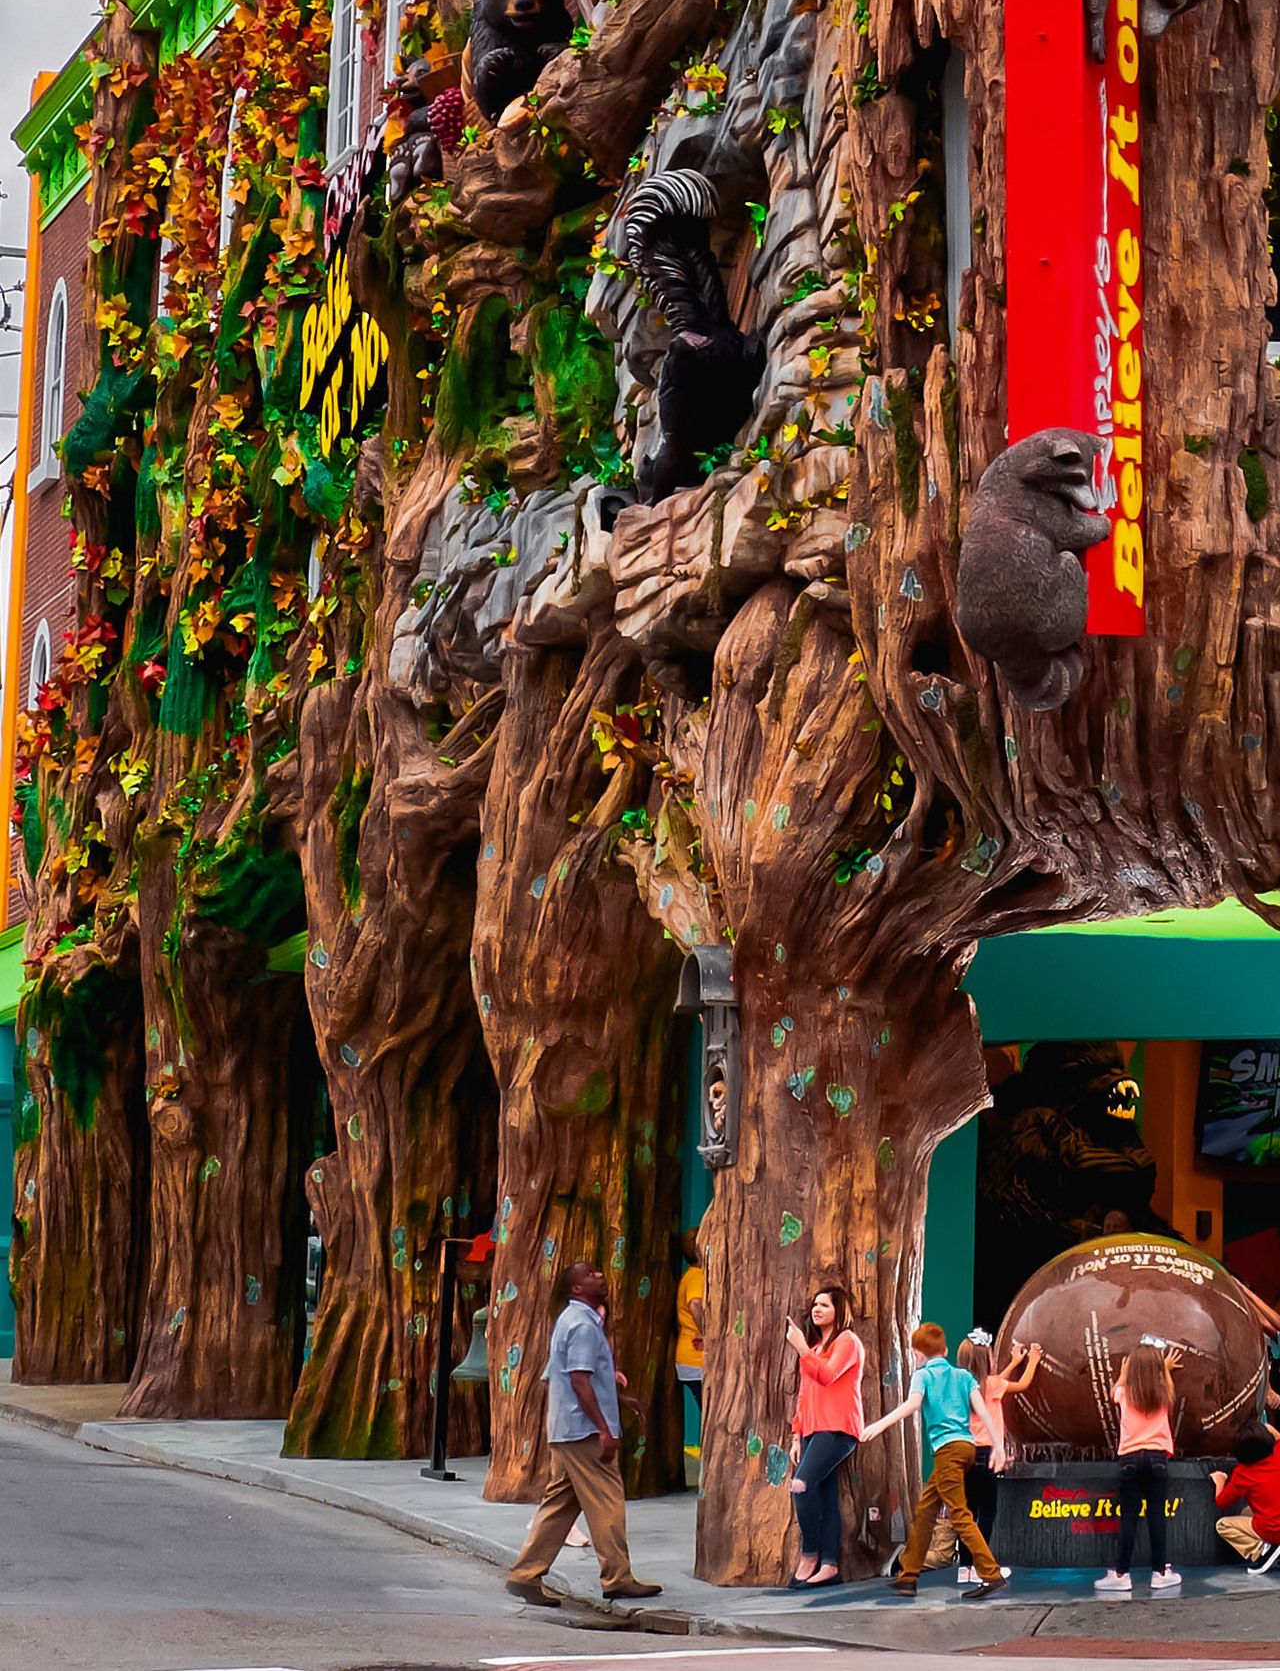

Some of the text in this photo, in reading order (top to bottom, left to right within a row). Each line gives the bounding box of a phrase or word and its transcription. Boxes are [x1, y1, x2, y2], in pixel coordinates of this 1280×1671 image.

[1109, 104, 1139, 206] It
[320, 351, 343, 458] or
[1113, 228, 1143, 608] Believe
[1110, 1253, 1131, 1264] or
[1133, 1253, 1151, 1266] It
[1154, 1253, 1215, 1280] Believe
[1029, 1499, 1092, 1519] Believe
[1094, 1498, 1112, 1518] It
